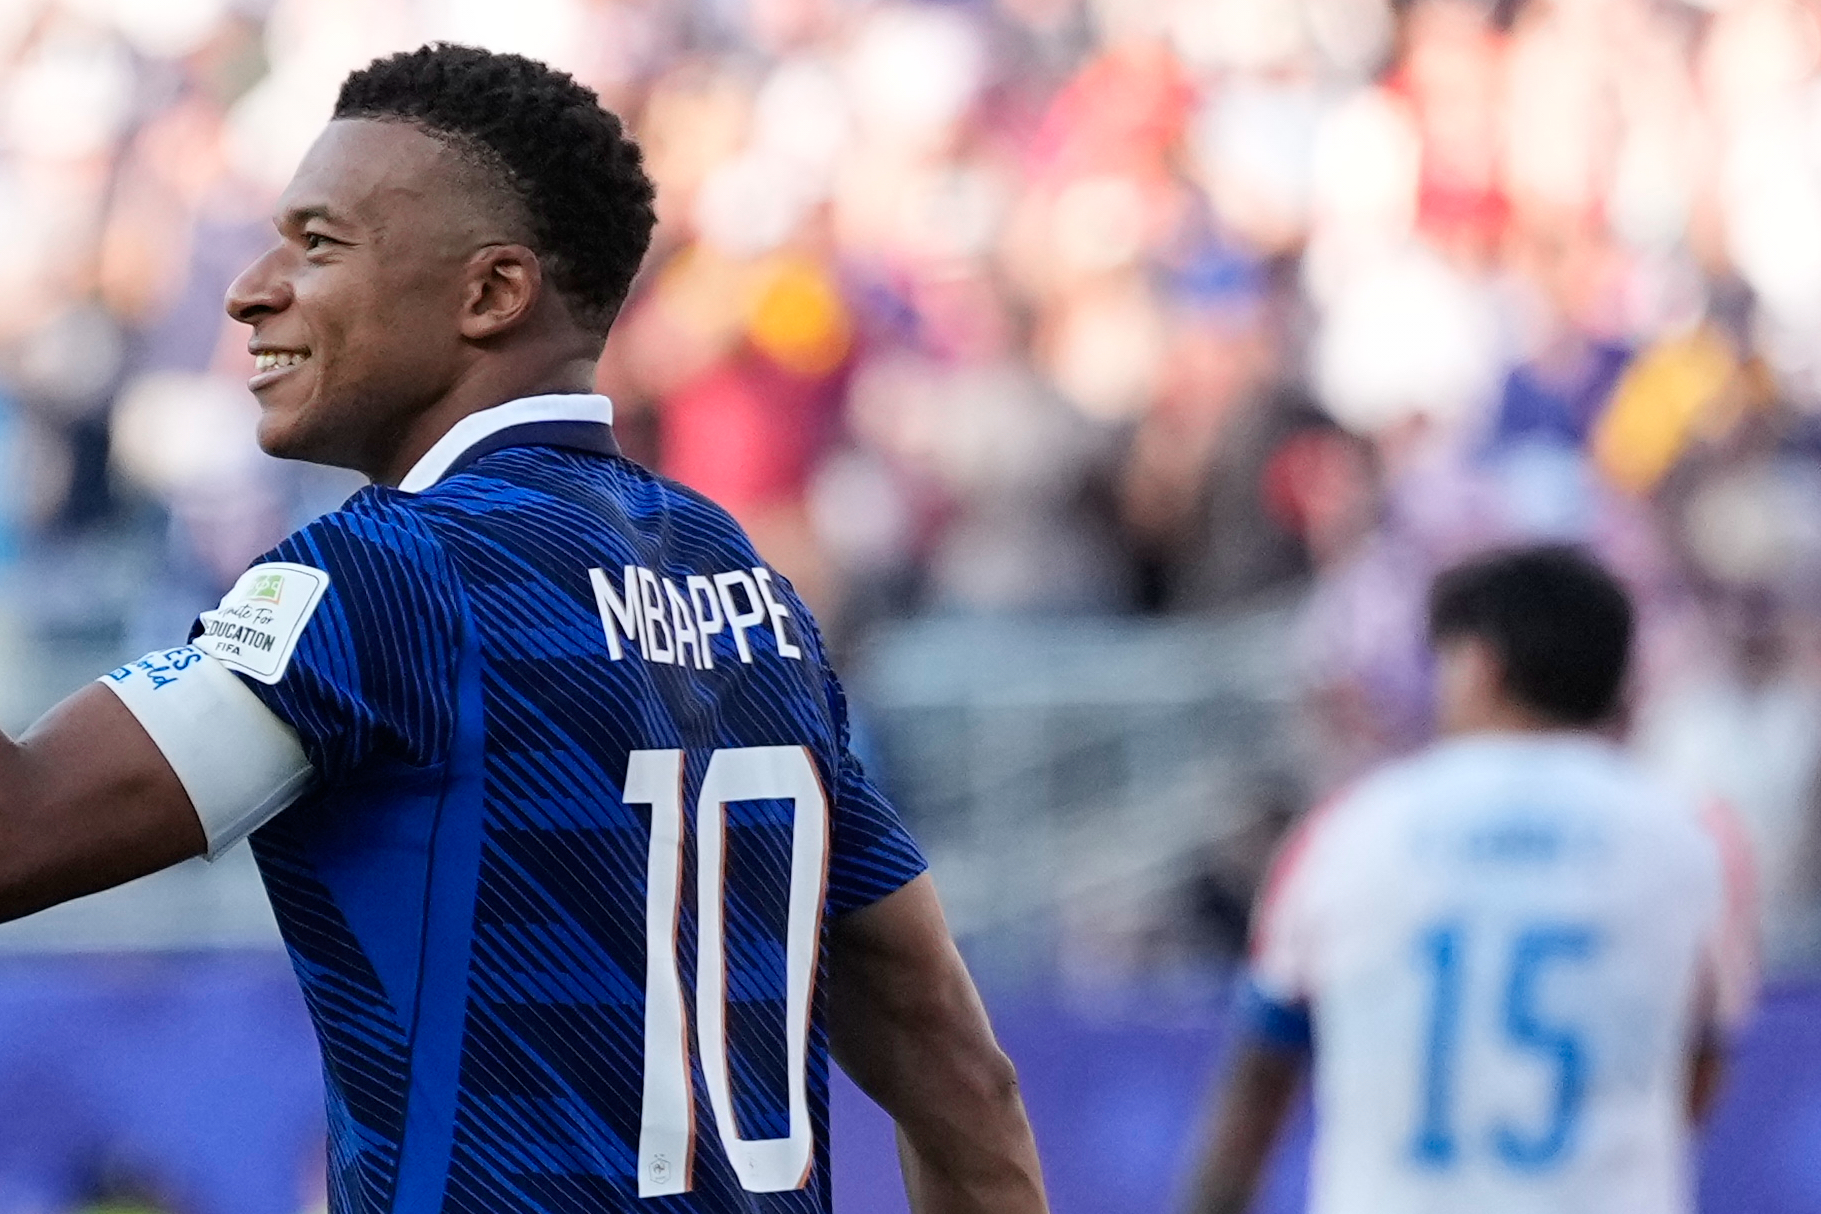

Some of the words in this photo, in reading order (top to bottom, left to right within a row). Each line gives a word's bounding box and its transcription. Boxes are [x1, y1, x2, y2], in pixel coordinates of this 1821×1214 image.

[215, 642, 241, 656] FIFA
[253, 608, 275, 625] For
[588, 565, 802, 670] MBAPPE
[136, 656, 179, 691] orld
[622, 745, 828, 1197] 10
[1408, 920, 1604, 1176] 15
